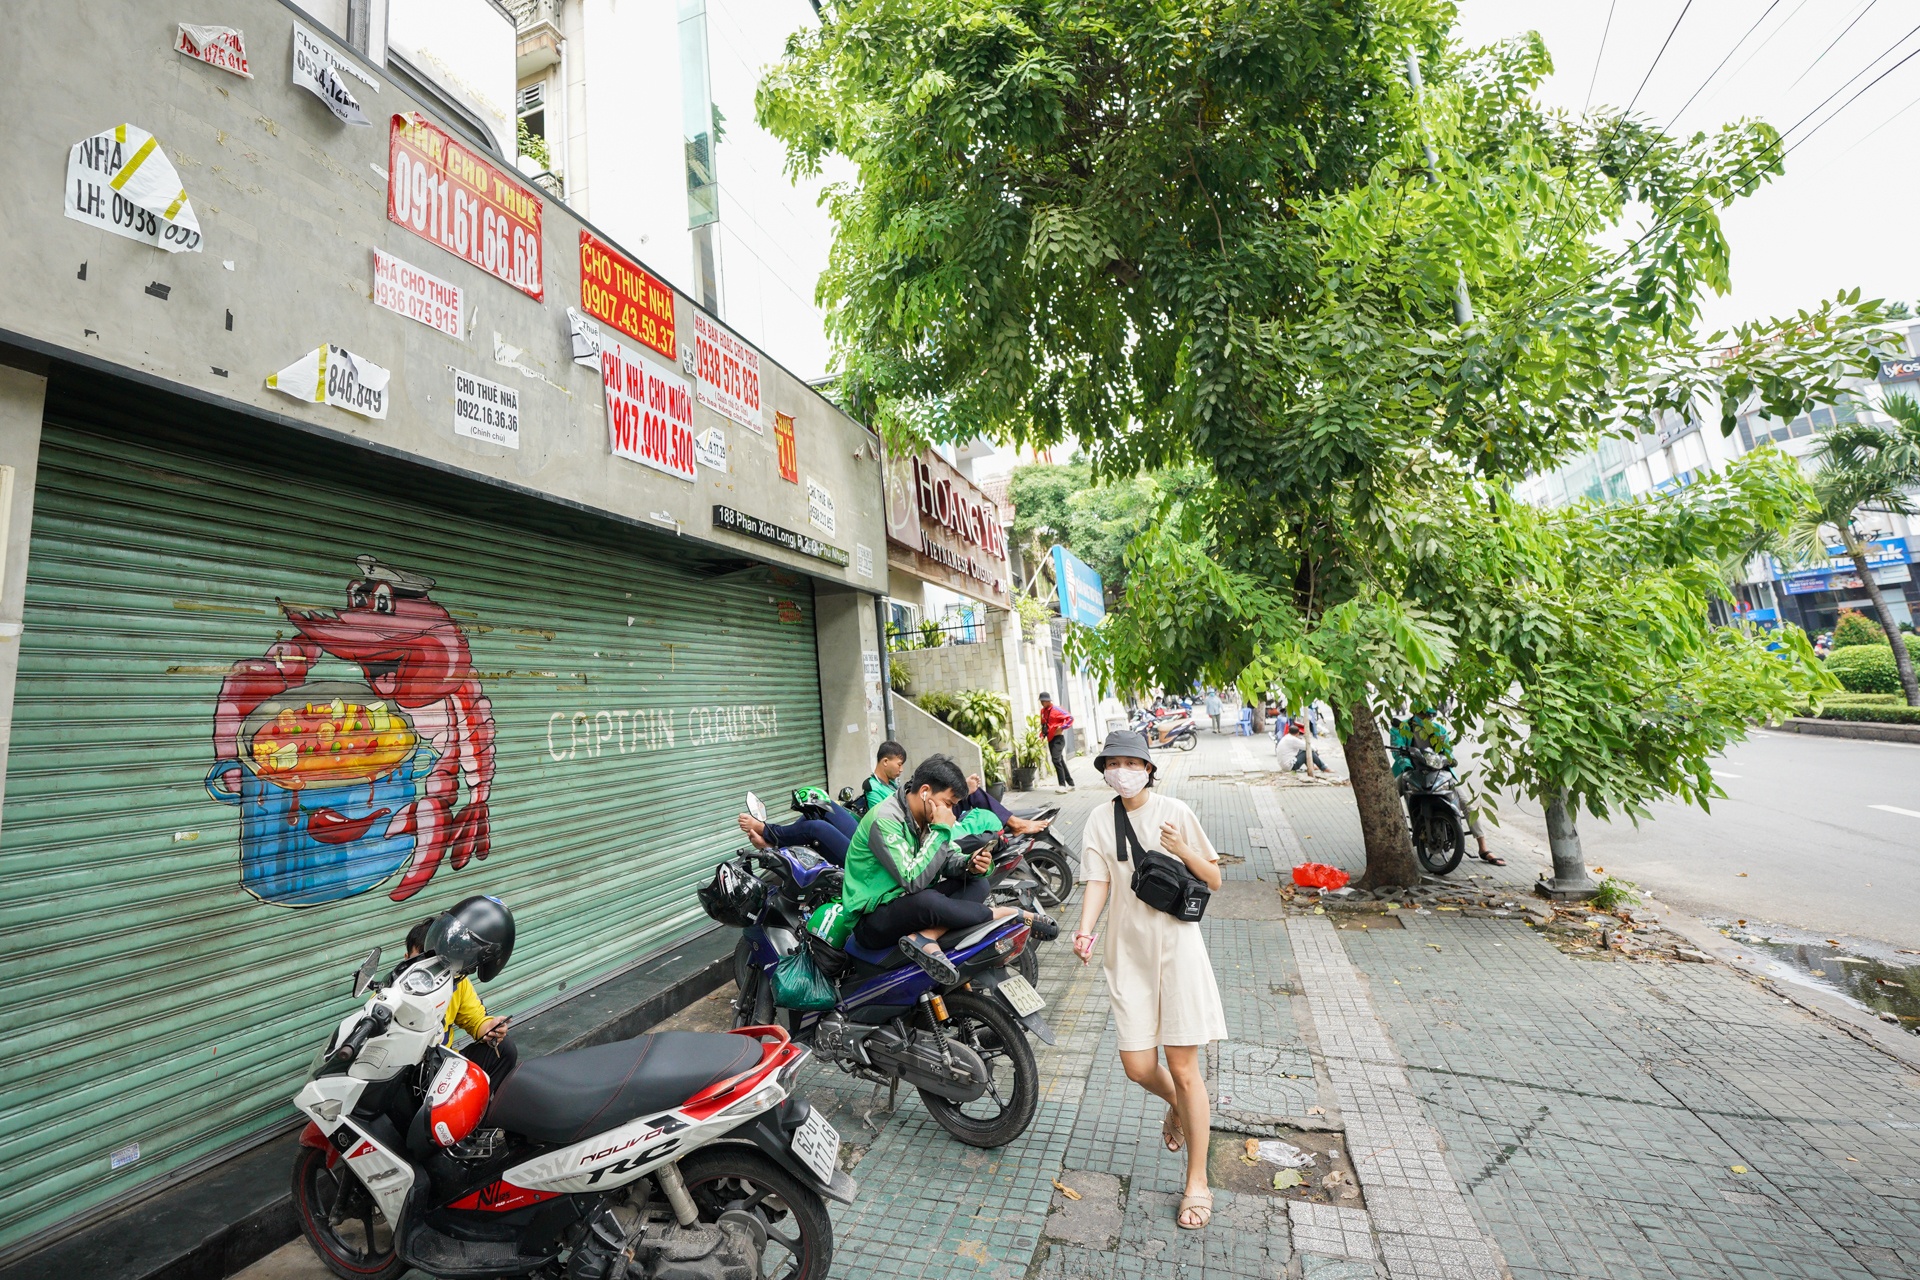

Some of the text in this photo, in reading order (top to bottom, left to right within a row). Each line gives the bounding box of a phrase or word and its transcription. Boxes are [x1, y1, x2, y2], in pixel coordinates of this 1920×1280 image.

[297, 31, 319, 55] Cho
[77, 178, 105, 220] LH:
[448, 147, 488, 193] CHO
[492, 176, 537, 225] THUÊ
[395, 150, 542, 294] 0911.61.66.68
[401, 267, 426, 297] CHO
[428, 280, 459, 312] THUÊ
[582, 243, 611, 285] CHO
[613, 262, 647, 308] THUÊ
[408, 295, 433, 324] 075
[435, 306, 459, 335] 915
[582, 279, 675, 355] 0907.43.59.37
[328, 363, 382, 413] 846.849
[457, 376, 518, 410] CHO THUÊ NHÀ
[602, 344, 622, 393] CHỦ
[626, 360, 645, 404] NHÀ
[648, 375, 666, 414] CHO
[696, 335, 721, 389] 0938
[723, 353, 741, 401] 575
[743, 366, 760, 412] 839
[457, 398, 518, 433] 0922.16.36.36
[719, 506, 735, 525] 188
[736, 510, 757, 533] Phan
[758, 520, 776, 539] Xích
[920, 528, 970, 576] VIETNAMESE
[548, 709, 675, 762] CAPTAIN
[813, 1123, 836, 1177] 177.46
